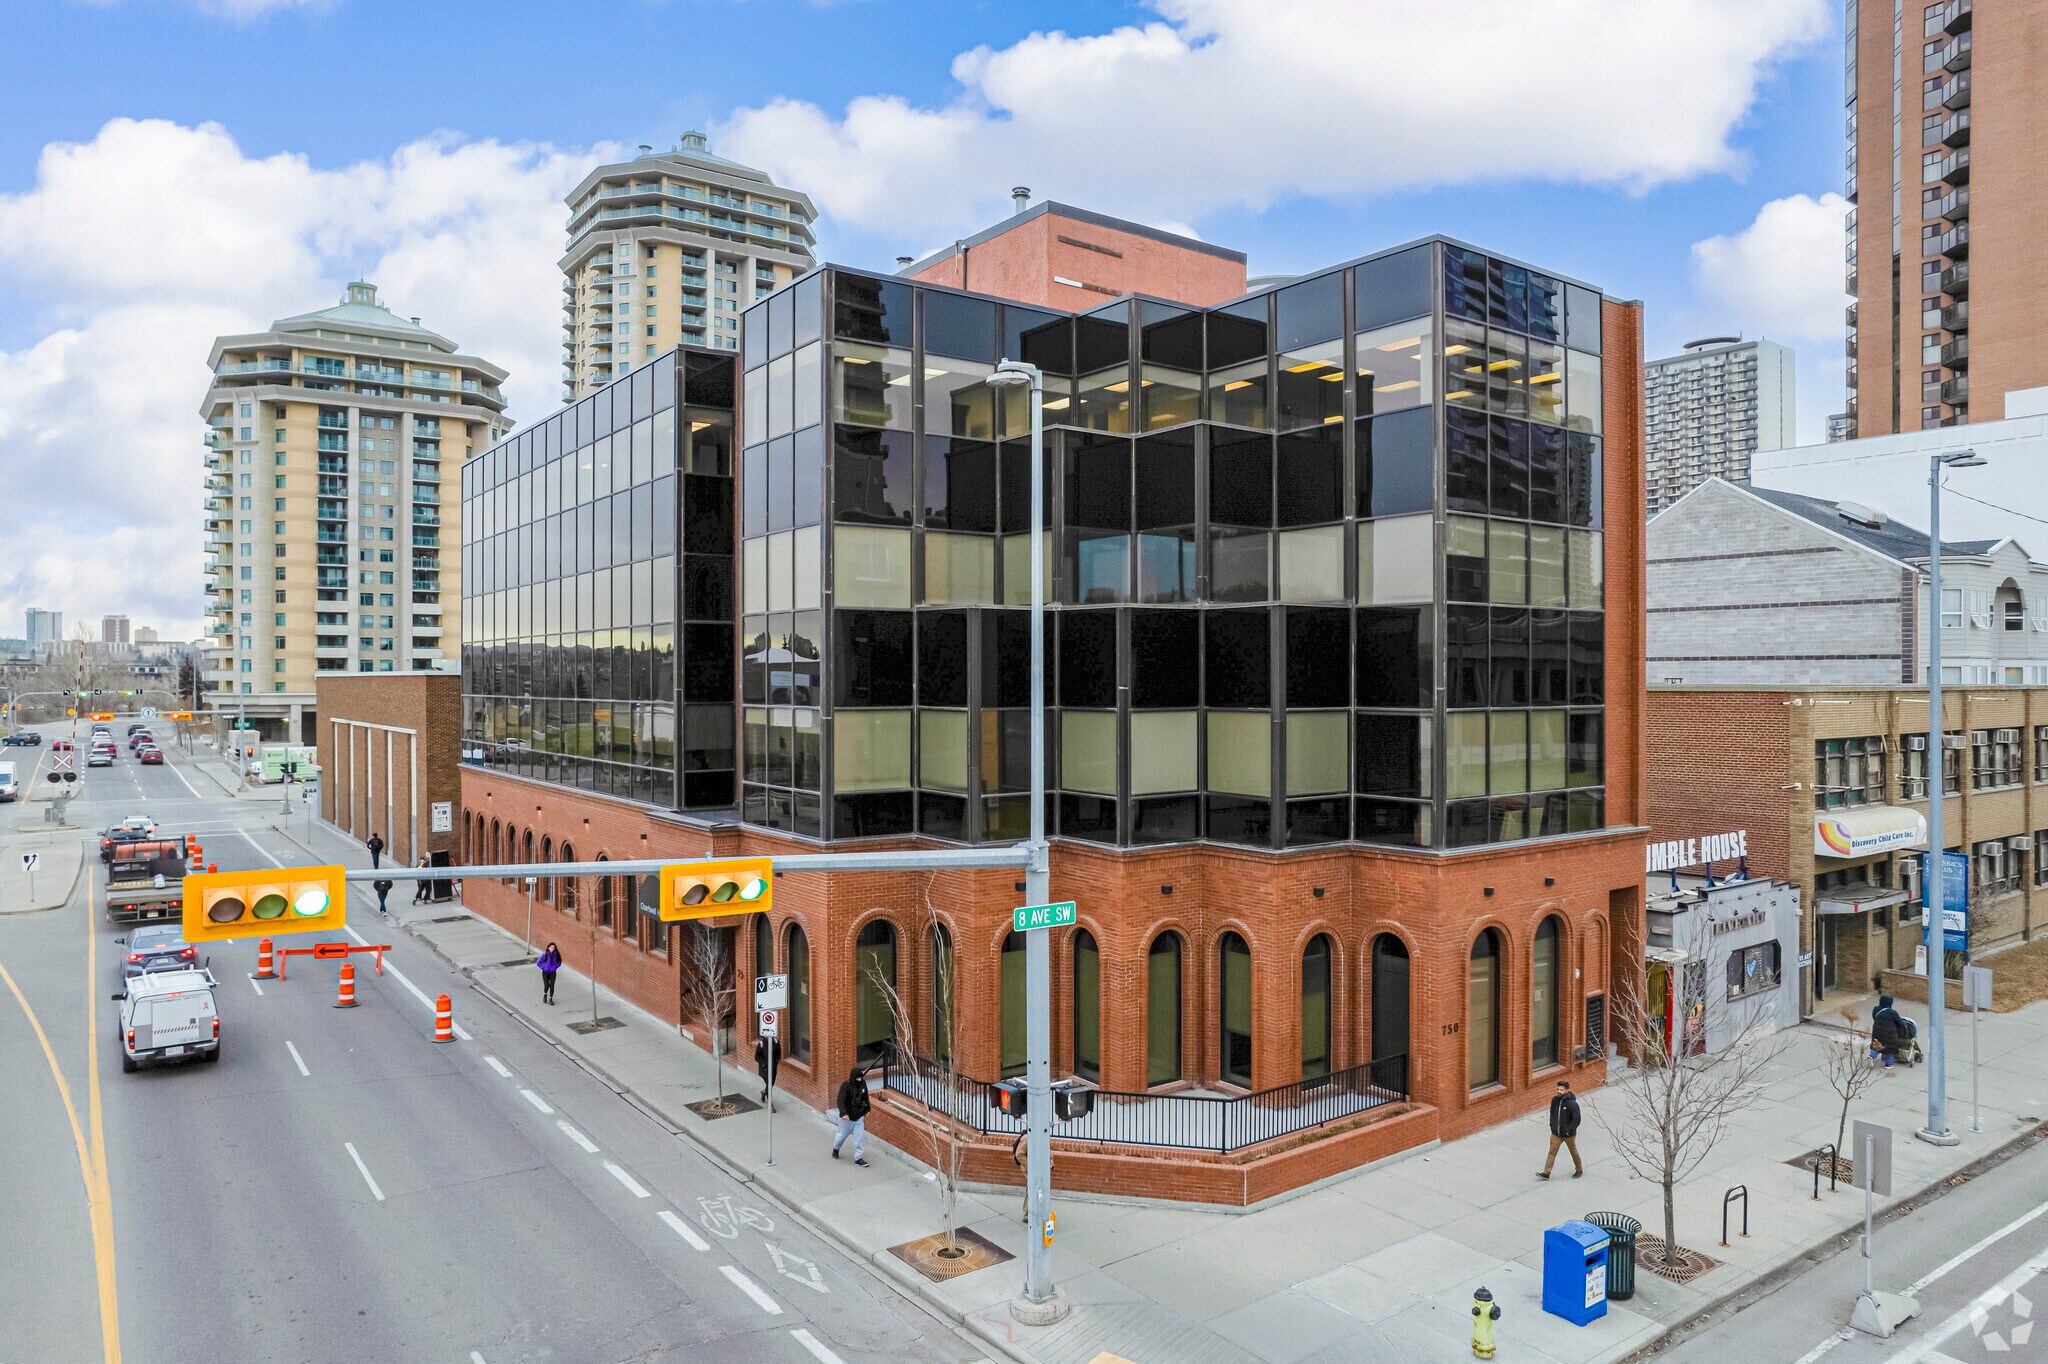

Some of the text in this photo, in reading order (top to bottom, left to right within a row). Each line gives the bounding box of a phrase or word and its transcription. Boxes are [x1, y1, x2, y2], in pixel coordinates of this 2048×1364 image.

[1701, 829, 1747, 863] HOUSE
[1851, 838, 1877, 848] Discovery
[1878, 834, 1891, 843] Child
[1892, 832, 1903, 840] Care
[1926, 859, 1963, 868] CSSICS
[1019, 906, 1071, 927] 8 AVE SW
[1441, 1023, 1459, 1036] 750
